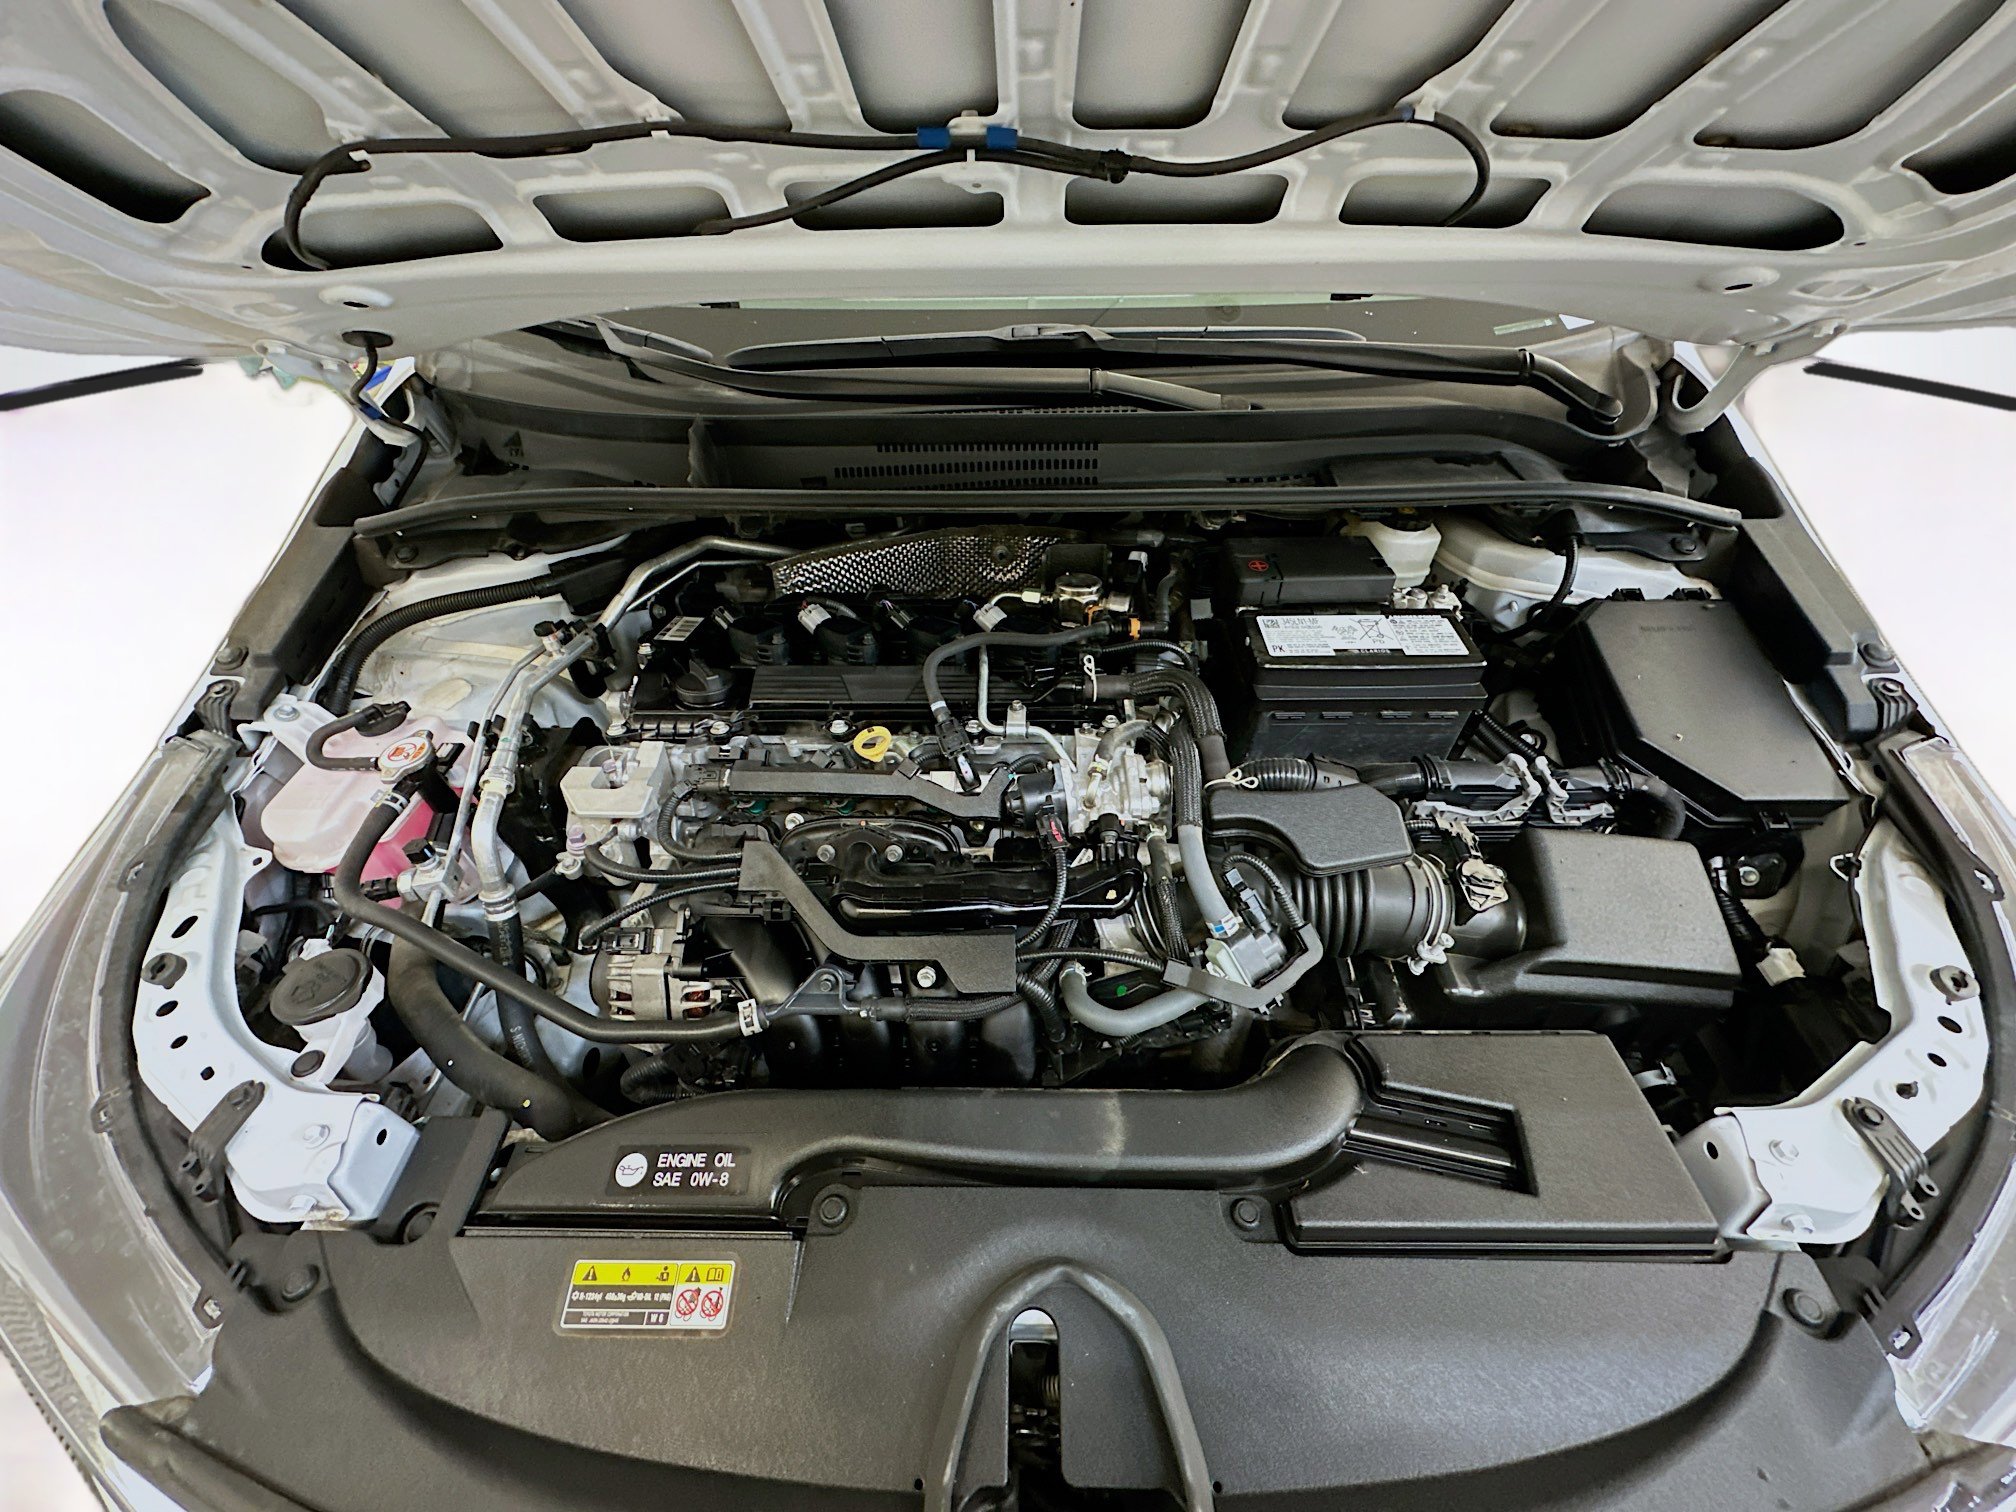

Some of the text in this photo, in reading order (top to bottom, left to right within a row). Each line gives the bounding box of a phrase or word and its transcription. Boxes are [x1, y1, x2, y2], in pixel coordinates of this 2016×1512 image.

[1271, 644, 1286, 653] PK
[657, 1152, 736, 1168] ENGINE OIL
[652, 1171, 730, 1187] SAE 0W-8
